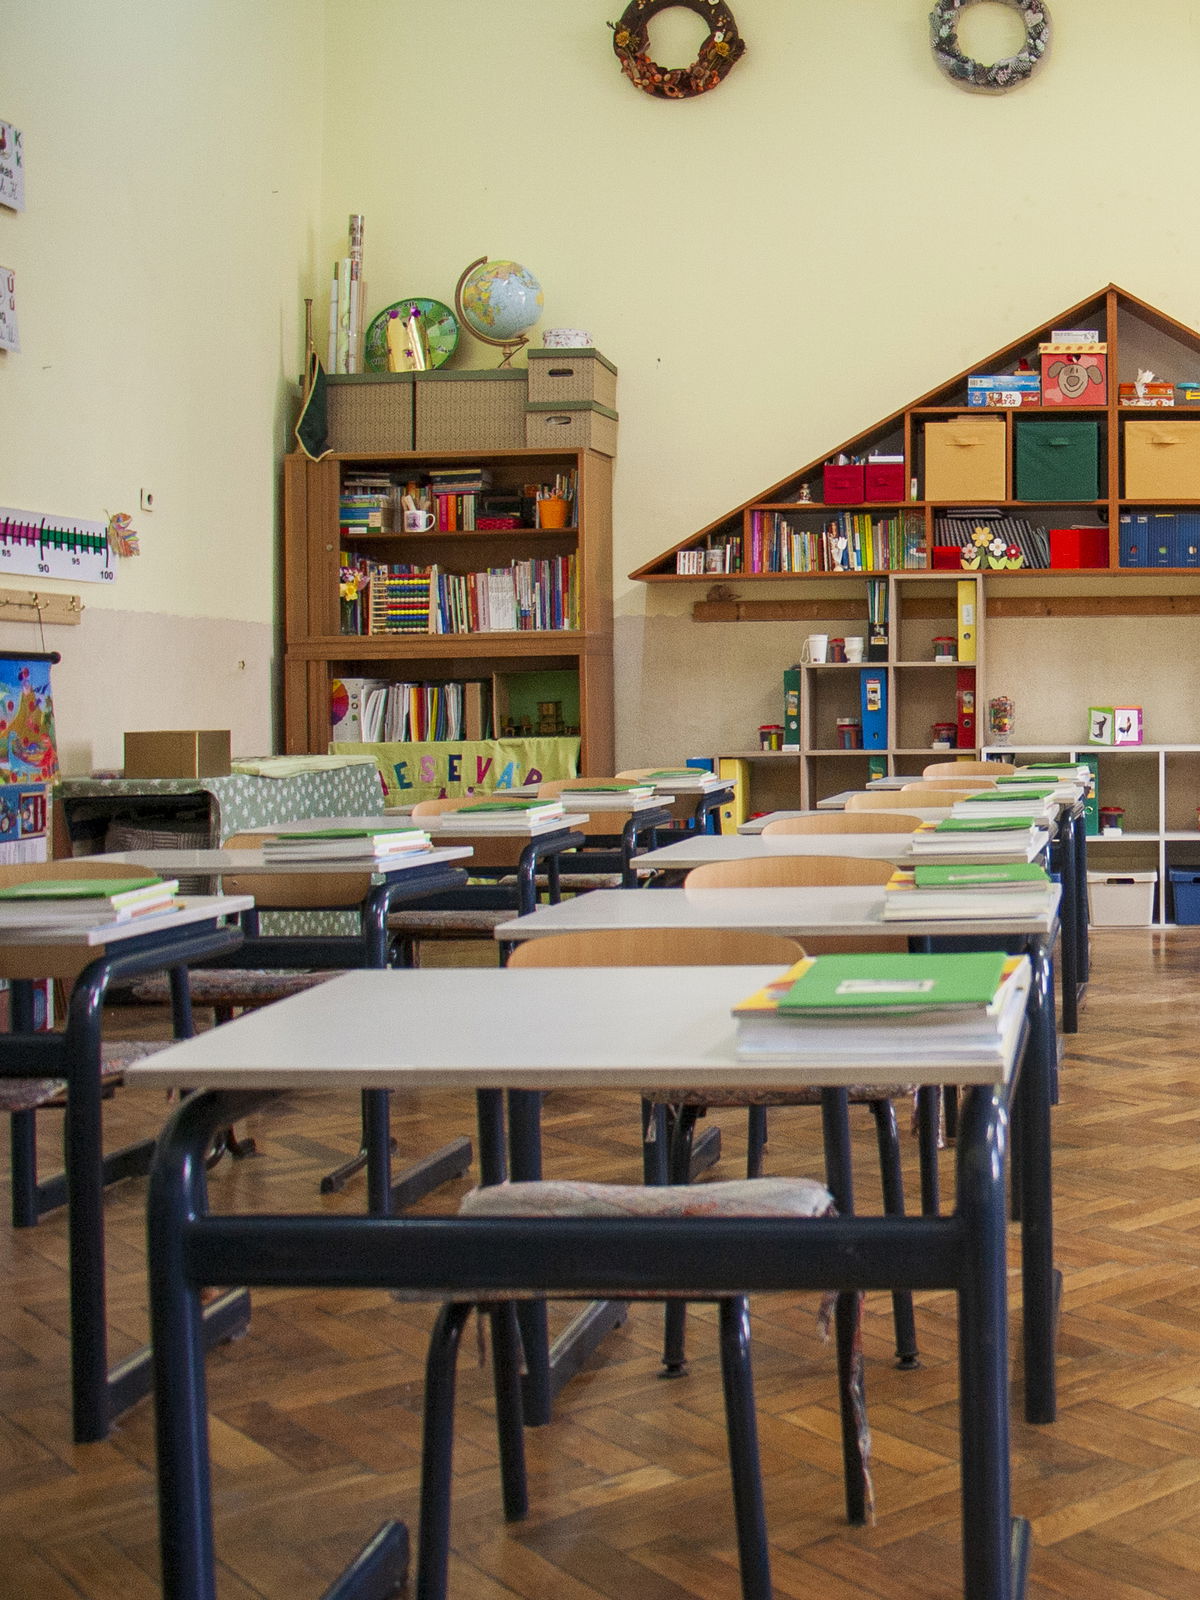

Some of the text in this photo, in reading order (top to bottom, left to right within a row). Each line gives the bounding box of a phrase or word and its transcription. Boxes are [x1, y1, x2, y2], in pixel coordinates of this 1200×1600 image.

[14, 130, 22, 148] K
[2, 549, 12, 557] 85
[72, 558, 81, 566] 95
[38, 563, 50, 573] 90
[100, 571, 114, 580] 100
